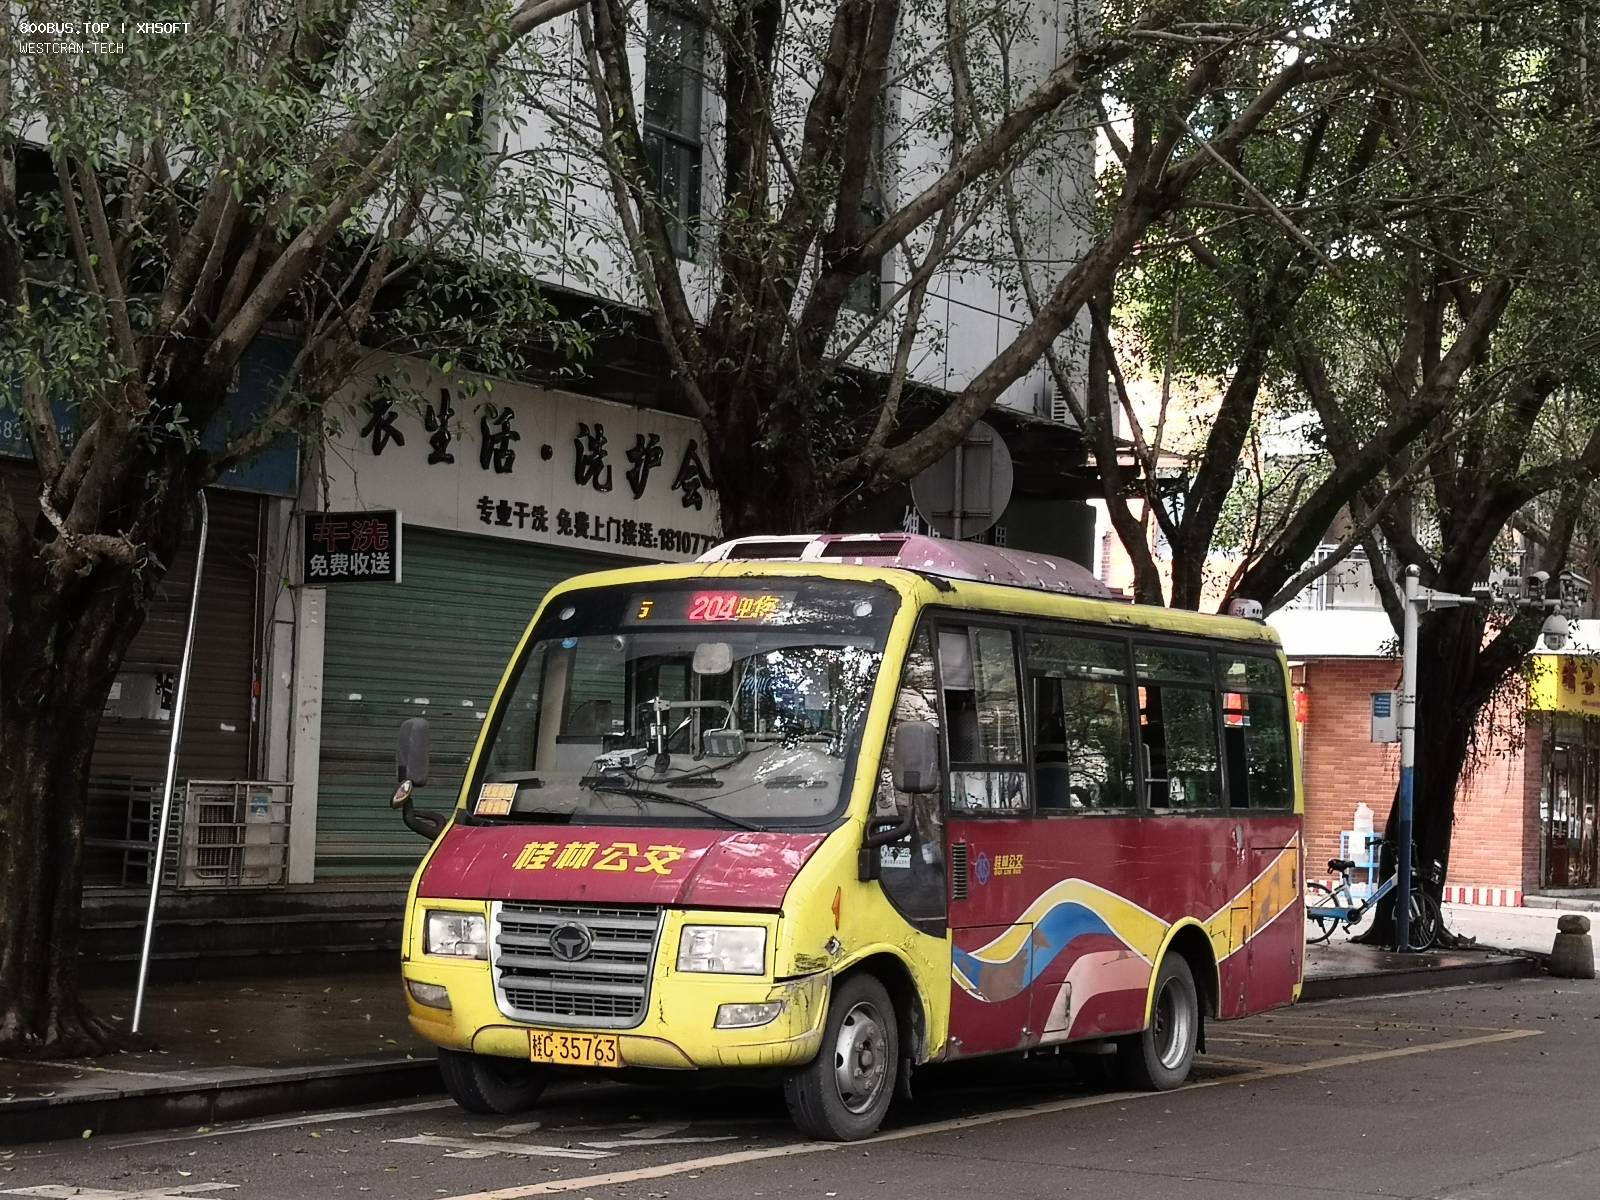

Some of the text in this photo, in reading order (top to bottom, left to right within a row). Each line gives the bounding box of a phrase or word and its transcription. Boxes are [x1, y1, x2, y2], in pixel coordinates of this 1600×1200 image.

[476, 495, 549, 532] 专业干洗
[312, 519, 390, 553] 干洗
[309, 551, 391, 577] 免费收送
[688, 595, 738, 621] 204
[511, 841, 687, 876] 桂林公交
